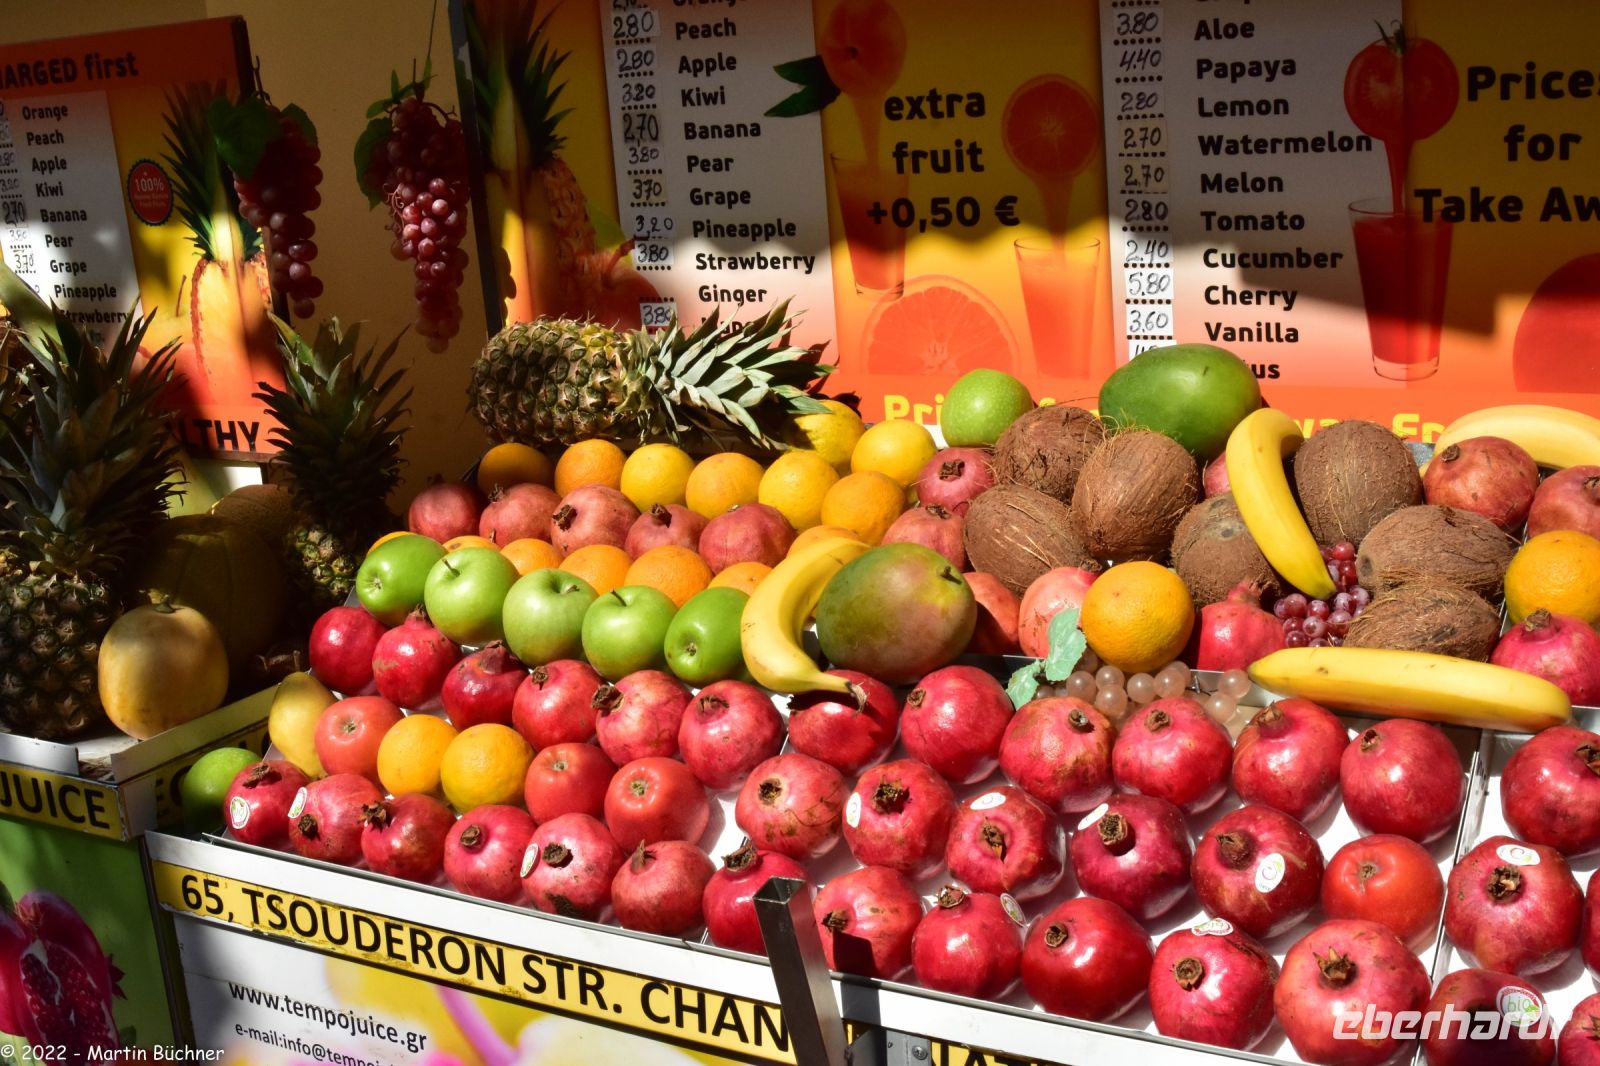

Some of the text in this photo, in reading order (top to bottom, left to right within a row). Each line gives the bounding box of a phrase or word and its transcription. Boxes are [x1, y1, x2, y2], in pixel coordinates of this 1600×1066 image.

[676, 18, 737, 41] Peach
[1194, 18, 1255, 41] Aloe
[0, 52, 139, 90] ARGED first
[678, 52, 737, 78] Apple
[1196, 58, 1297, 84] Papaya
[1468, 61, 1600, 101] Price
[681, 86, 726, 108] Kiwi
[884, 88, 986, 121] extra
[1197, 97, 1290, 118] Lemon
[22, 104, 68, 121] Orange
[26, 129, 64, 146] Peach
[684, 122, 761, 140] Banana
[1504, 124, 1582, 161] for
[1198, 130, 1373, 156] Watermelon
[31, 155, 67, 174] Apple
[687, 155, 734, 173] Pear
[892, 139, 985, 174] fruit
[36, 182, 64, 197] Kiwi
[1200, 172, 1283, 194] Melon
[690, 187, 751, 209] Grape
[1414, 187, 1600, 222] Take Aw
[40, 208, 87, 223] Banana
[867, 195, 1021, 233] +0,50 €
[1200, 210, 1305, 232] Tomato
[45, 234, 74, 248] Pear
[692, 218, 797, 242] Pineapple
[50, 259, 87, 277] Grape
[695, 252, 815, 275] Strawberry
[1203, 247, 1344, 269] Cucumber
[54, 283, 117, 301] Pineapple
[1128, 271, 1171, 296] 5.80
[699, 284, 768, 307] Ginger
[1204, 285, 1298, 311] Cherry
[1205, 322, 1299, 343] Vanilla
[0, 771, 110, 830] JUICE
[181, 875, 790, 1053] 65, TSOUDERON STR. CHAN
[228, 982, 427, 1053] www.tempojuice.gr
